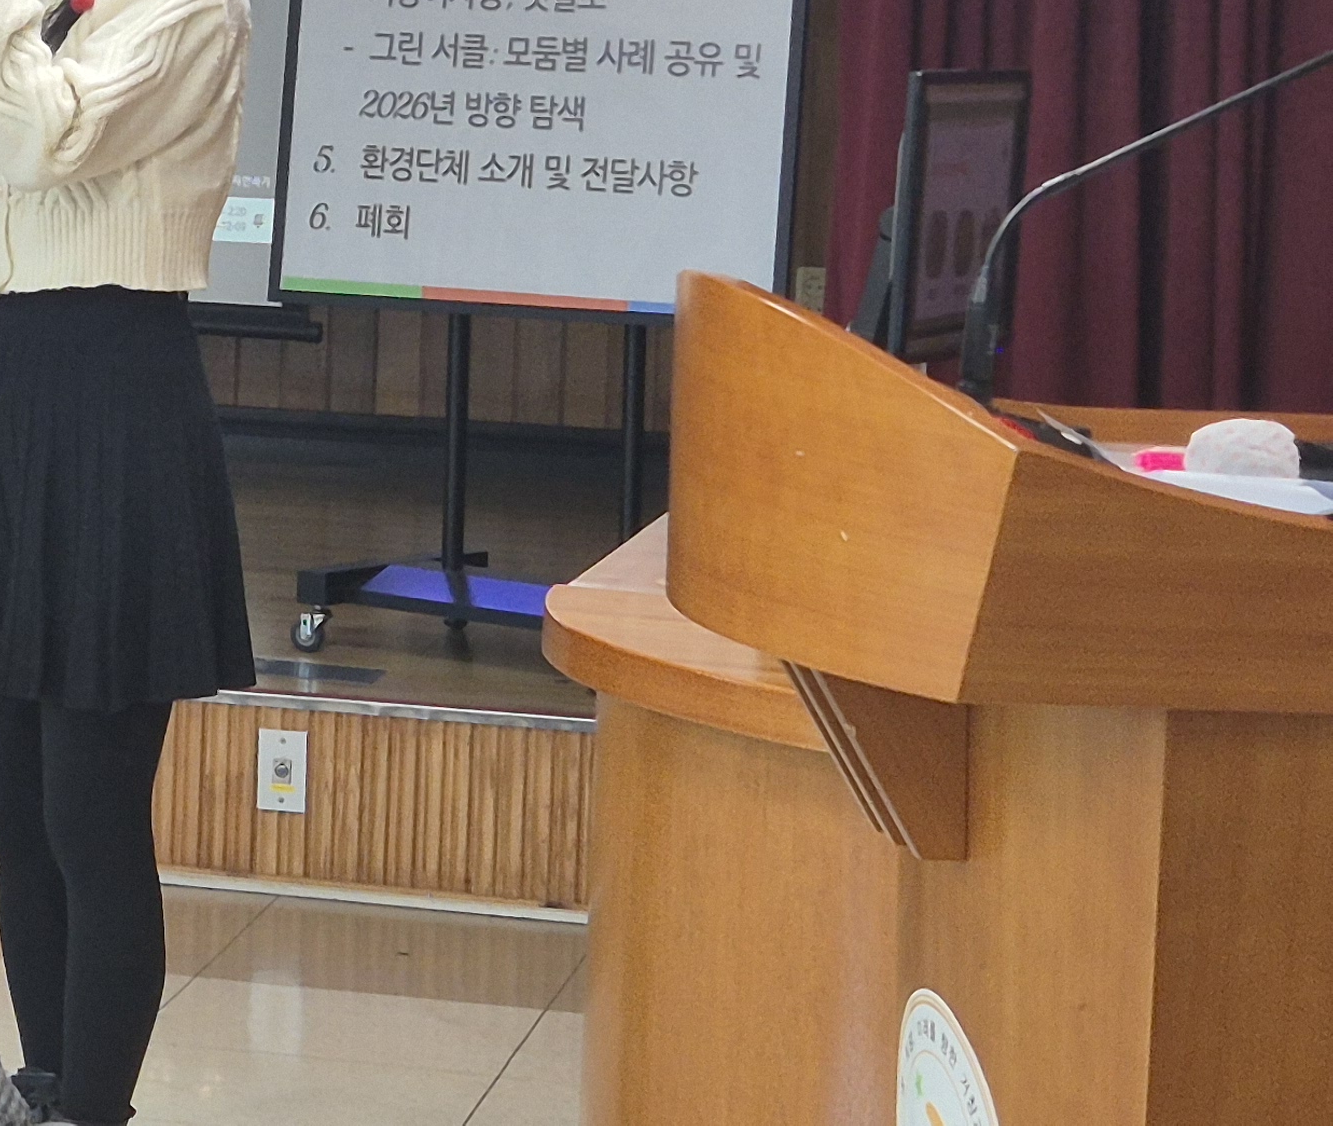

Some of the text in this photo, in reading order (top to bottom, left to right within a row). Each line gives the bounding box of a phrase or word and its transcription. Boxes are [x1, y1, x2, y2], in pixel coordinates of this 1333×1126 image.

[369, 32, 423, 66] 그린
[432, 33, 498, 69] 서클:
[503, 37, 587, 72] 모둠별
[597, 38, 655, 75] 사례
[664, 41, 723, 77] 공유
[735, 44, 761, 79] 및
[359, 90, 585, 132] 2026년 방향 탐색
[314, 145, 699, 197] 5. 환경단체 소개 및 전달사항
[309, 203, 410, 240] 6. 폐회
